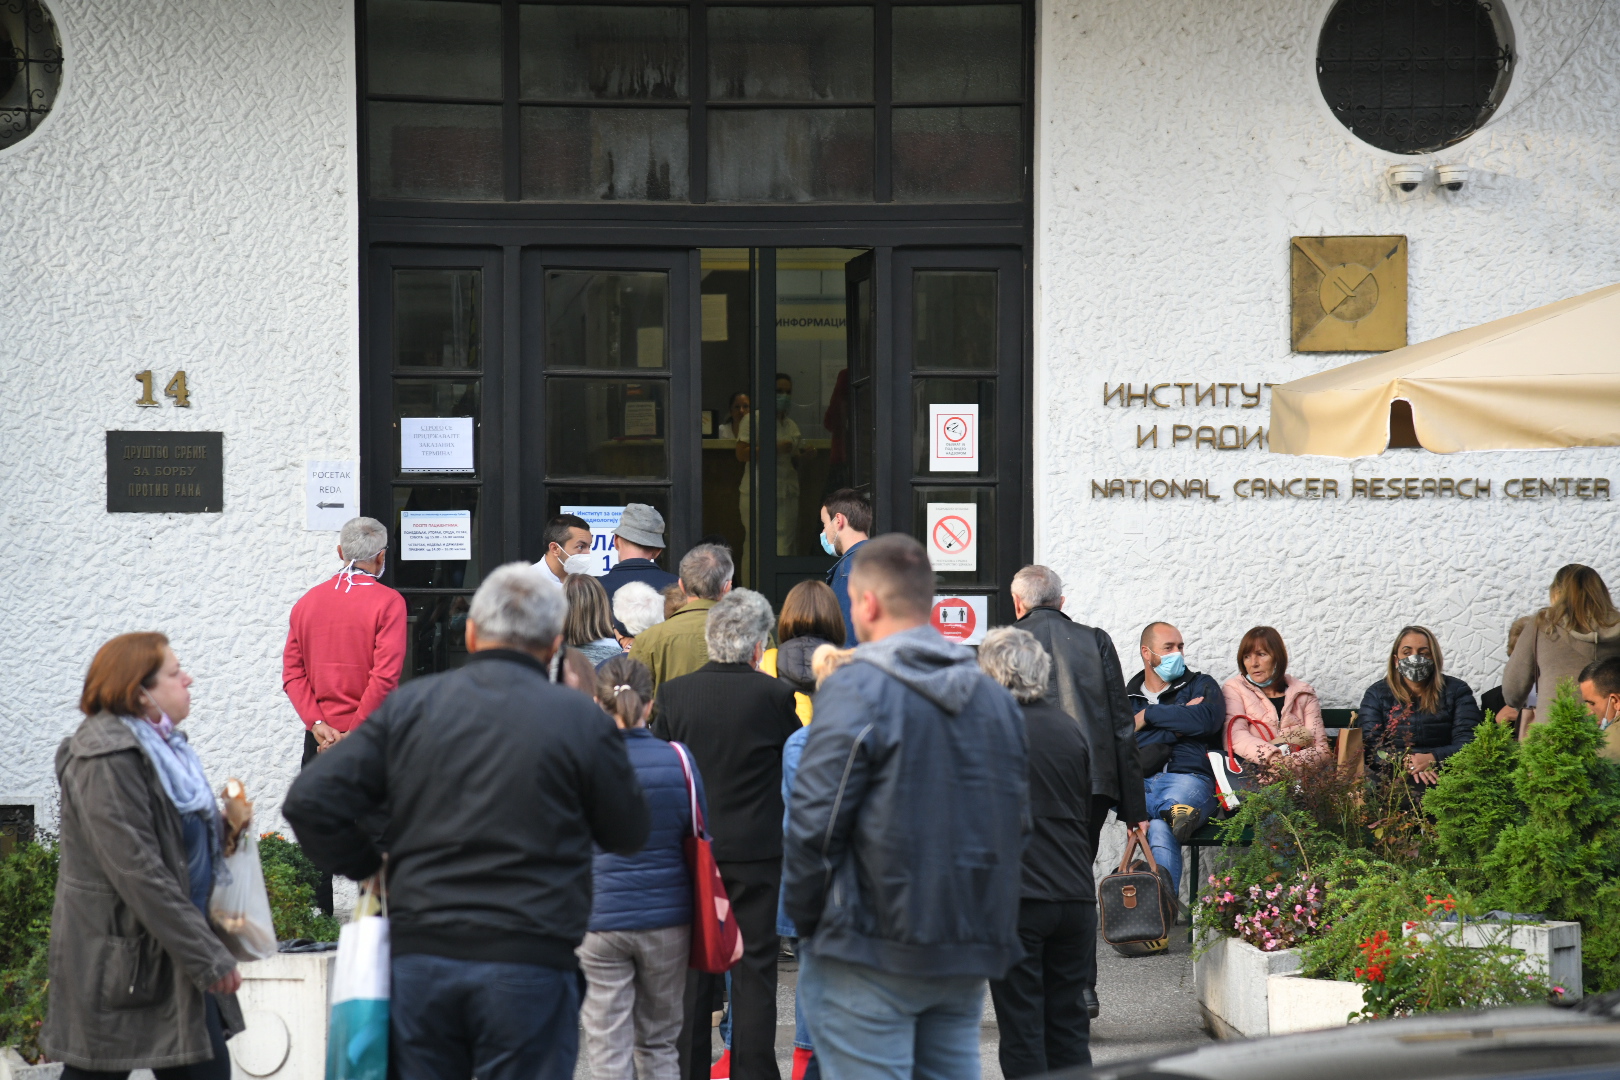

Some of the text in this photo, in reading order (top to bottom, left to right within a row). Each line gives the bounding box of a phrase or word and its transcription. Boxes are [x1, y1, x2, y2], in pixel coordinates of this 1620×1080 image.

[776, 318, 846, 328] ИНФОРМАЦИ
[135, 370, 190, 407] 14
[1136, 424, 1270, 450] И РАДИ
[123, 445, 207, 460] ДРУШТВО СРБИЈЕ
[133, 466, 197, 476] ЗА БОРБУ
[312, 471, 351, 479] POCETAK
[128, 483, 169, 497] ПРОТИВ
[319, 486, 342, 494] REDA
[1091, 477, 1610, 500] NATIONAL CANCER RESEARCH CENTER
